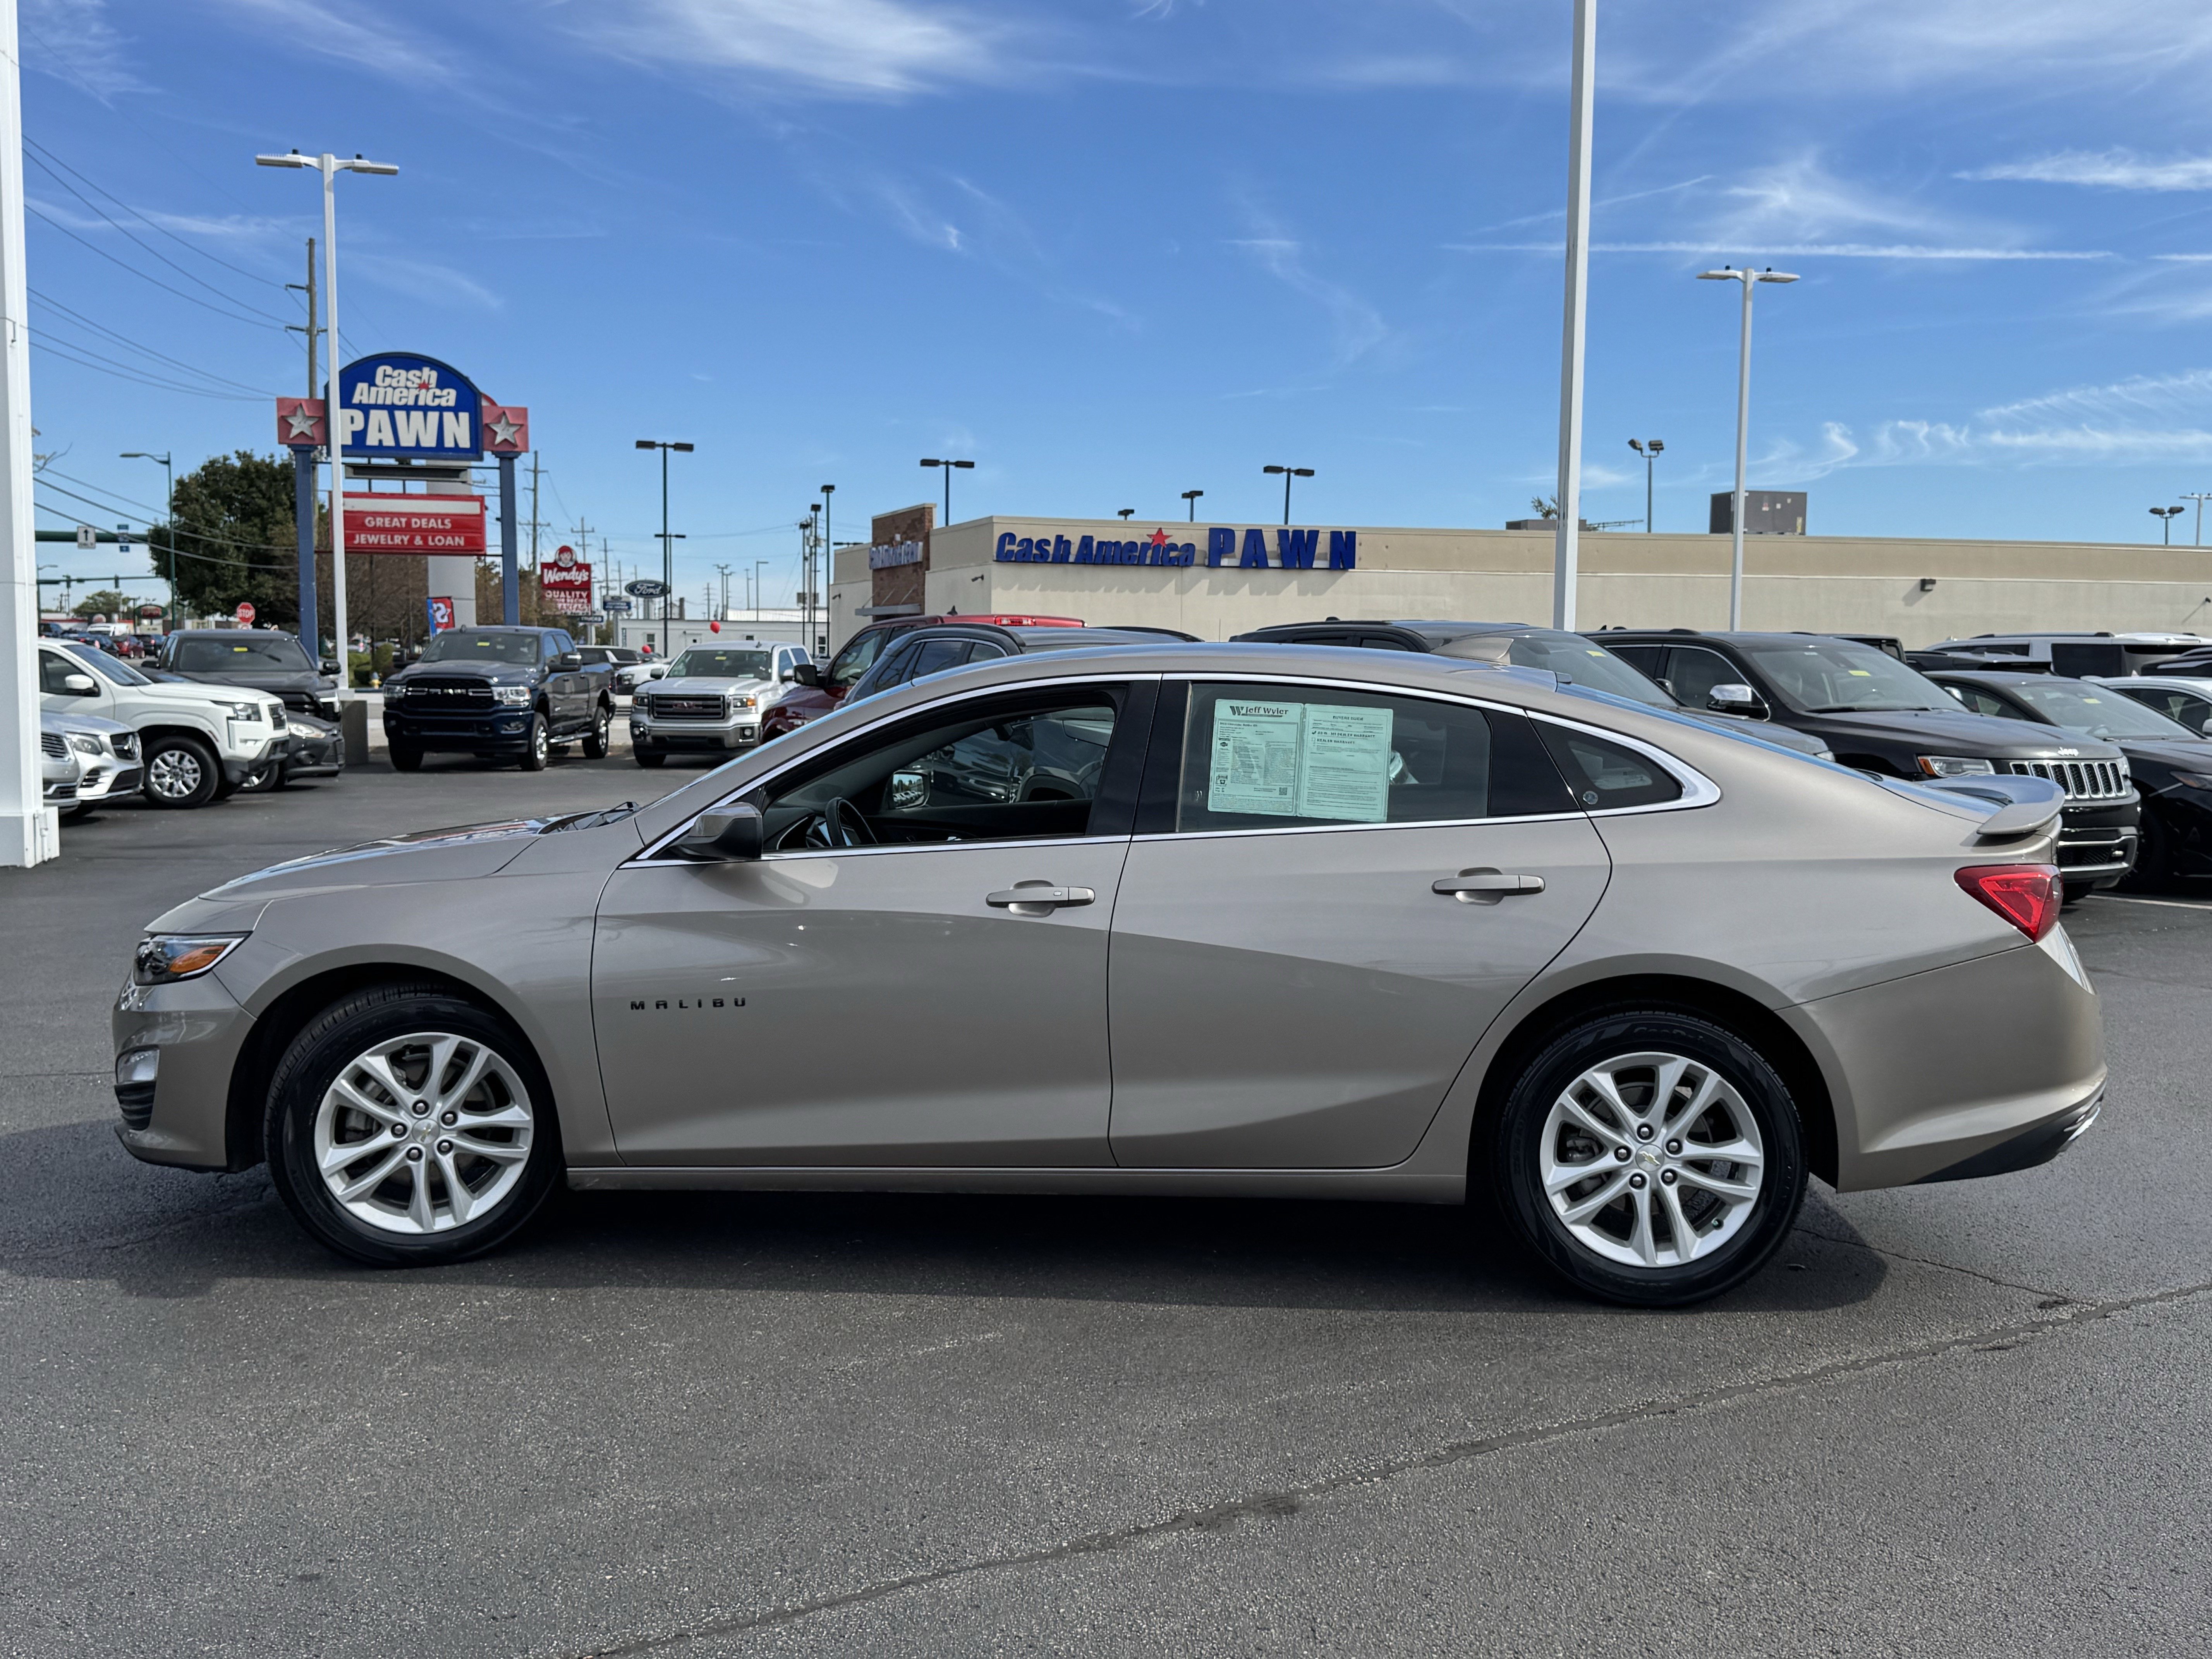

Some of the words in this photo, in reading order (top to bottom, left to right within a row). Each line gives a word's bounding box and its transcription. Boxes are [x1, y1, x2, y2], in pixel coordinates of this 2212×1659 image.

[375, 365, 438, 388] Cash
[352, 382, 457, 407] America
[340, 409, 470, 448] PAWN
[365, 517, 407, 528] GREAT
[412, 518, 452, 529] DEALS
[354, 534, 410, 545] JEWELRY
[414, 535, 423, 546] &
[428, 536, 464, 546] LOAN
[996, 532, 1071, 563] Cash
[1074, 535, 1195, 567] America
[1207, 527, 1356, 570] PAWN
[544, 566, 589, 585] Wendy's
[545, 590, 588, 599] QUALITY
[634, 583, 662, 594] Ford
[238, 608, 254, 618] STOP
[1263, 707, 1289, 715] Wyler
[630, 997, 746, 1010] MALIBU
